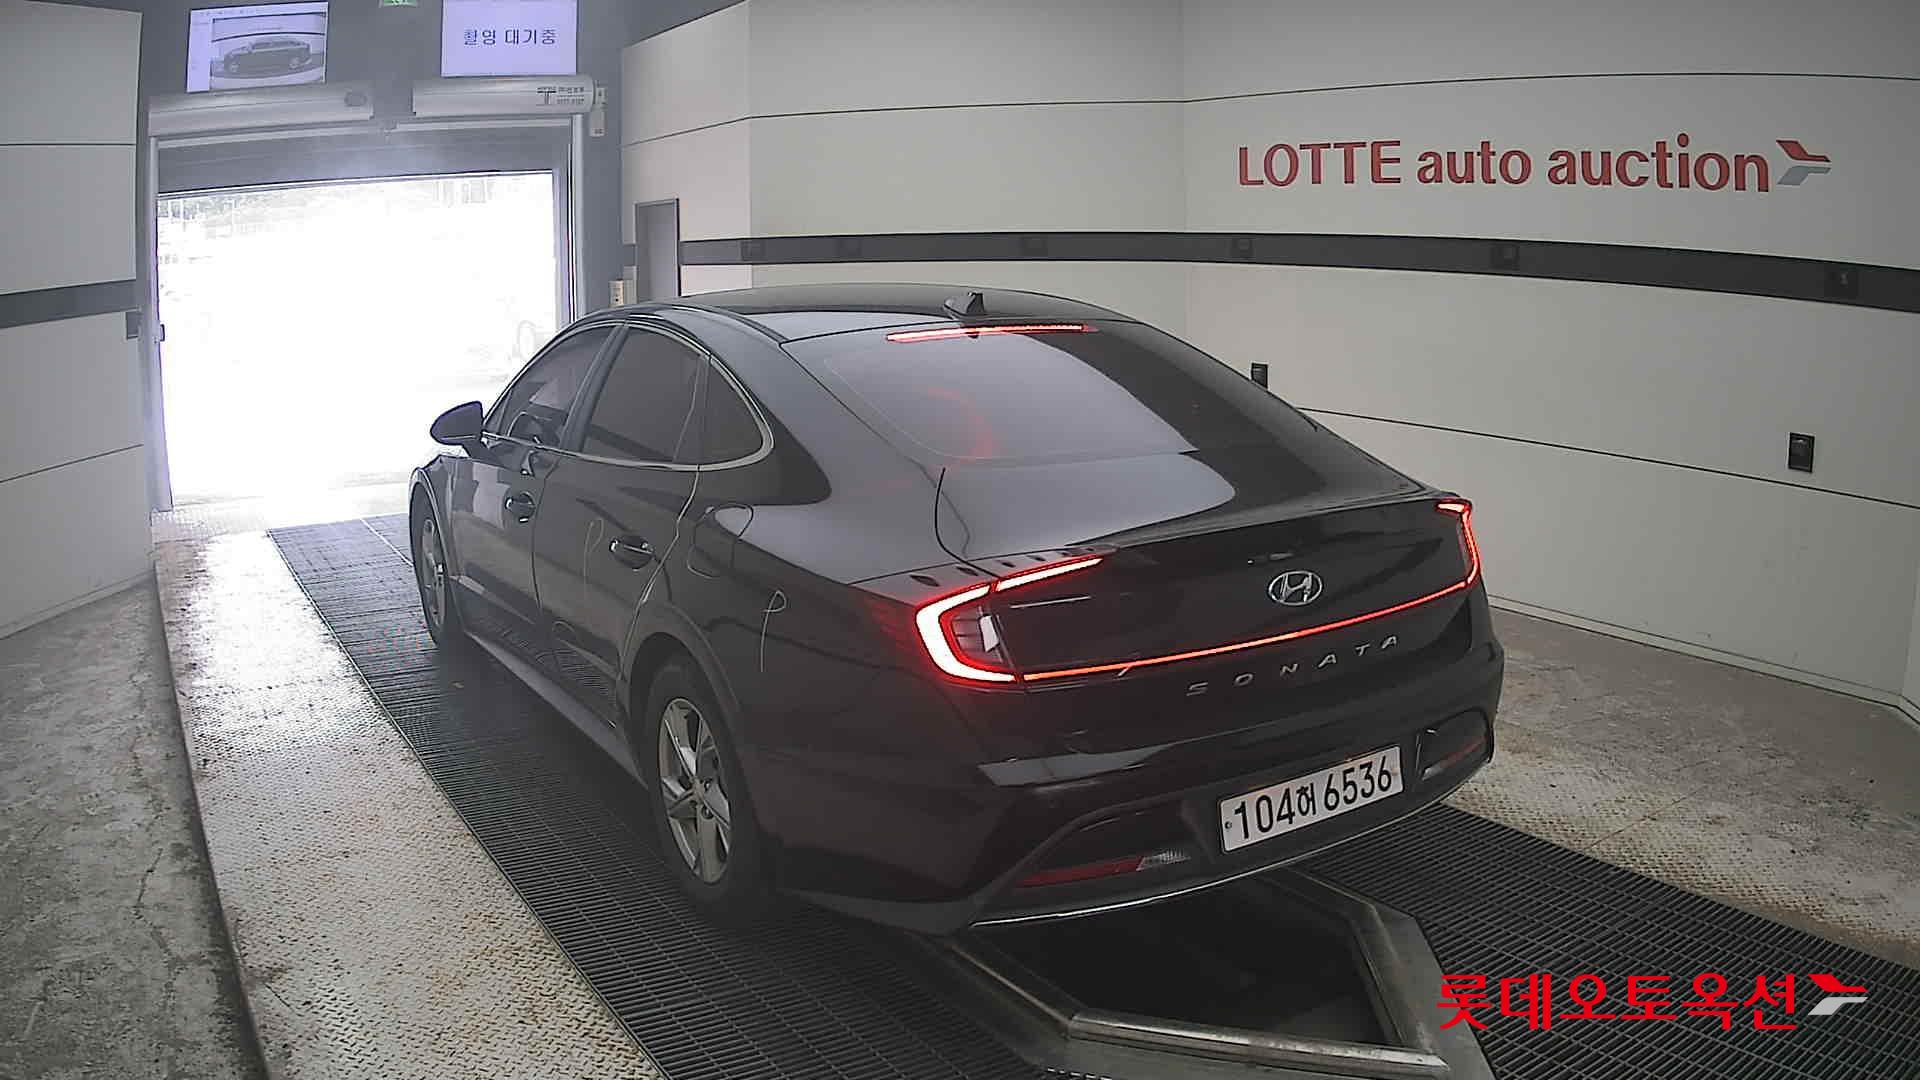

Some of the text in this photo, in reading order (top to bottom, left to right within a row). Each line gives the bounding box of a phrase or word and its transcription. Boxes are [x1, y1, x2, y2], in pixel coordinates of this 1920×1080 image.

[504, 28, 557, 46] 대기중
[1239, 132, 1770, 192] LOTTE auto auction
[1186, 635, 1398, 697] SONATA
[1324, 755, 1393, 812] 6536
